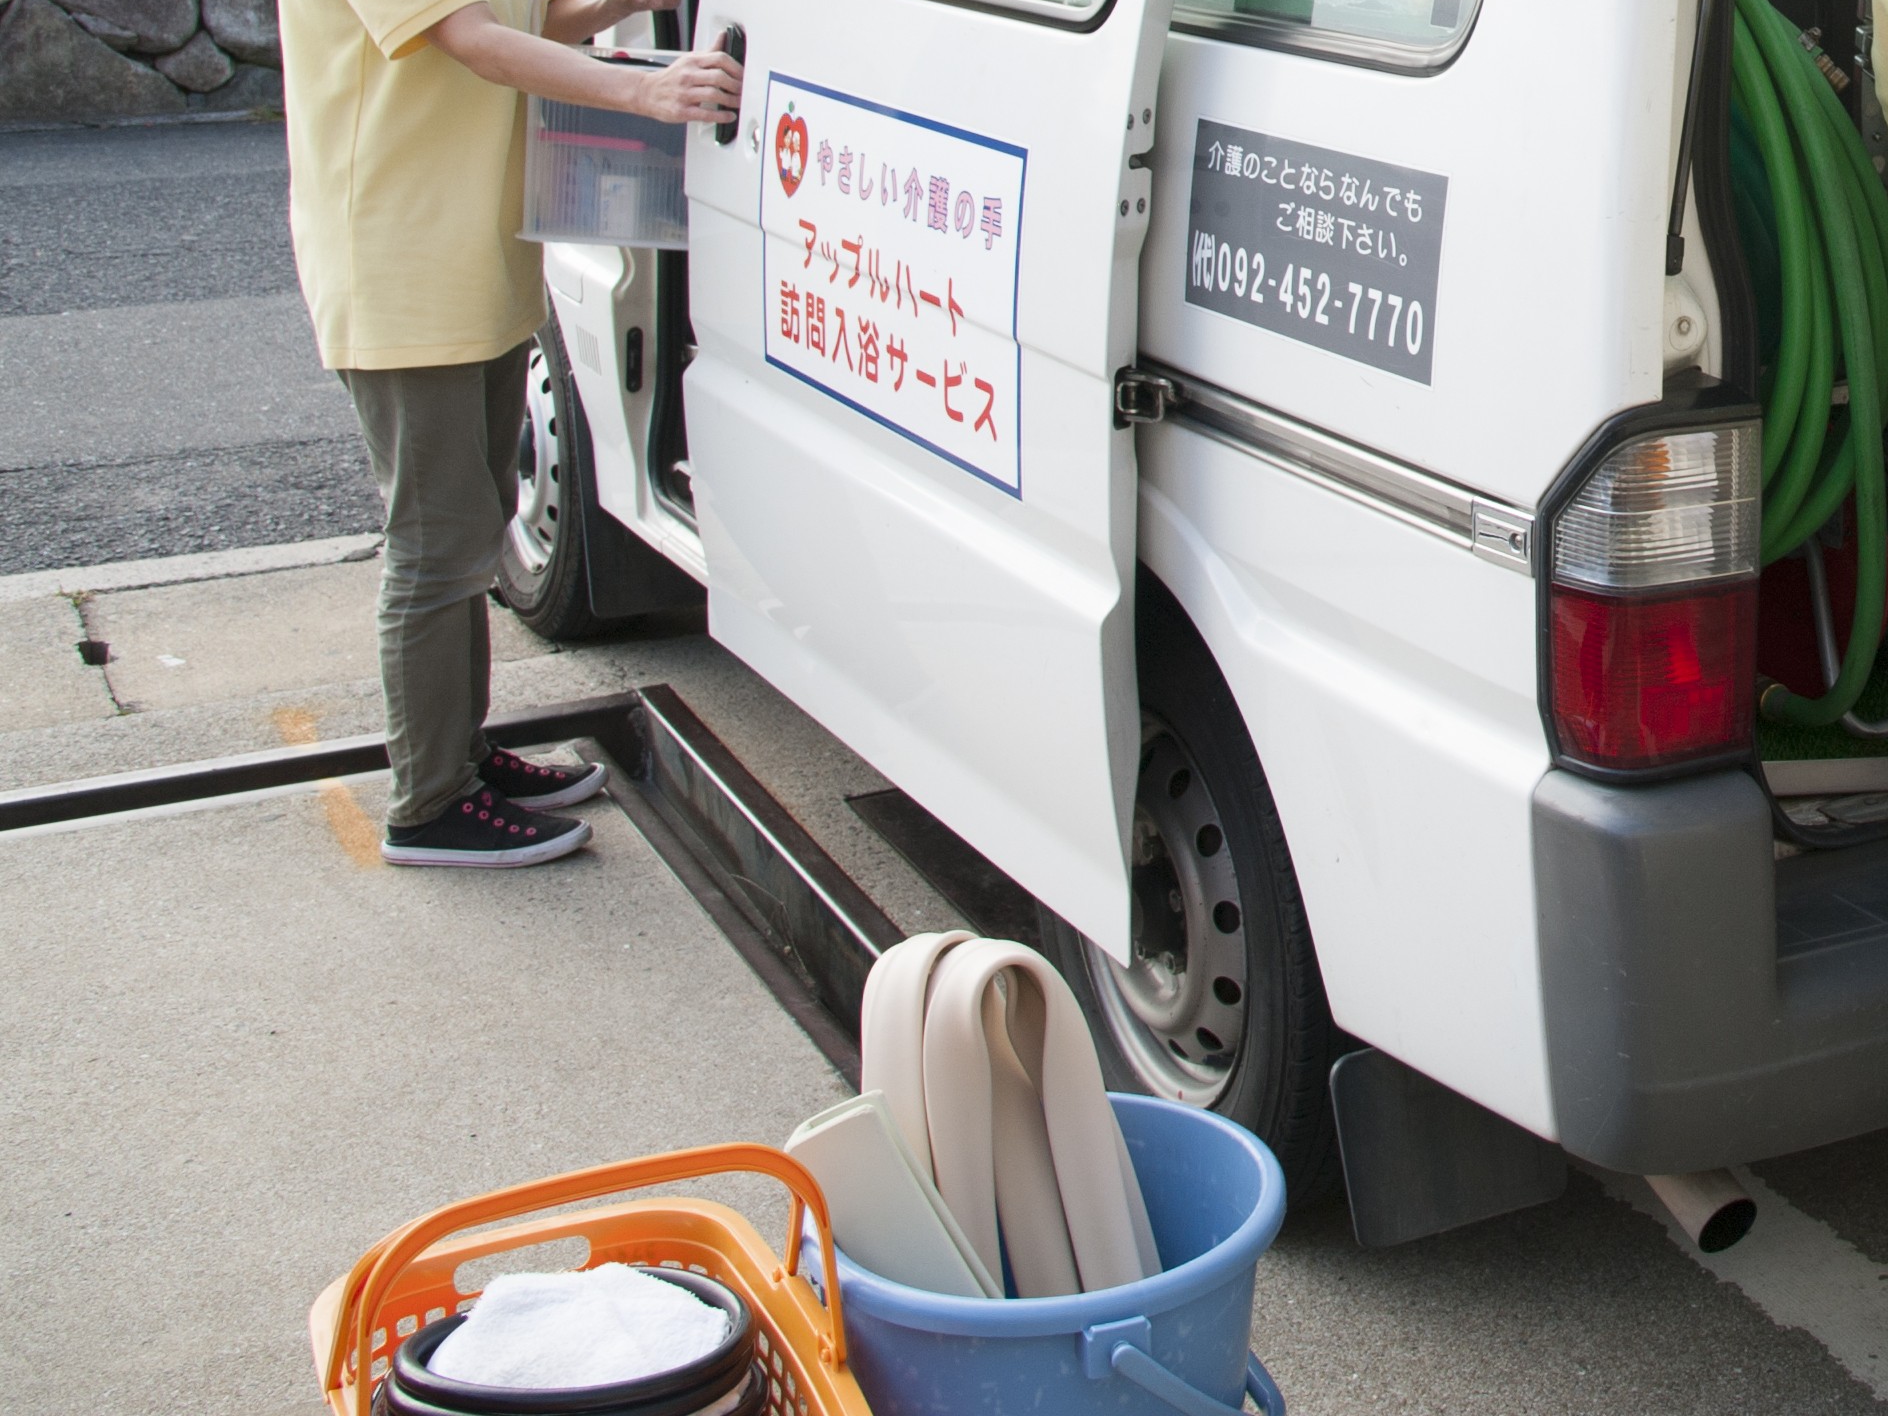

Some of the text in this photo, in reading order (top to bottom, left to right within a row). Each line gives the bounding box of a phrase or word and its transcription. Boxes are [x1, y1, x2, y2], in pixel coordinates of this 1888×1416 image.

[817, 138, 1004, 251] やさしい介護の手
[1208, 141, 1422, 222] 介護のことならなんでも
[1276, 202, 1408, 266] ご相談下さい。
[799, 219, 965, 339] アップルハート
[780, 281, 997, 441] 訪問入浴サービス
